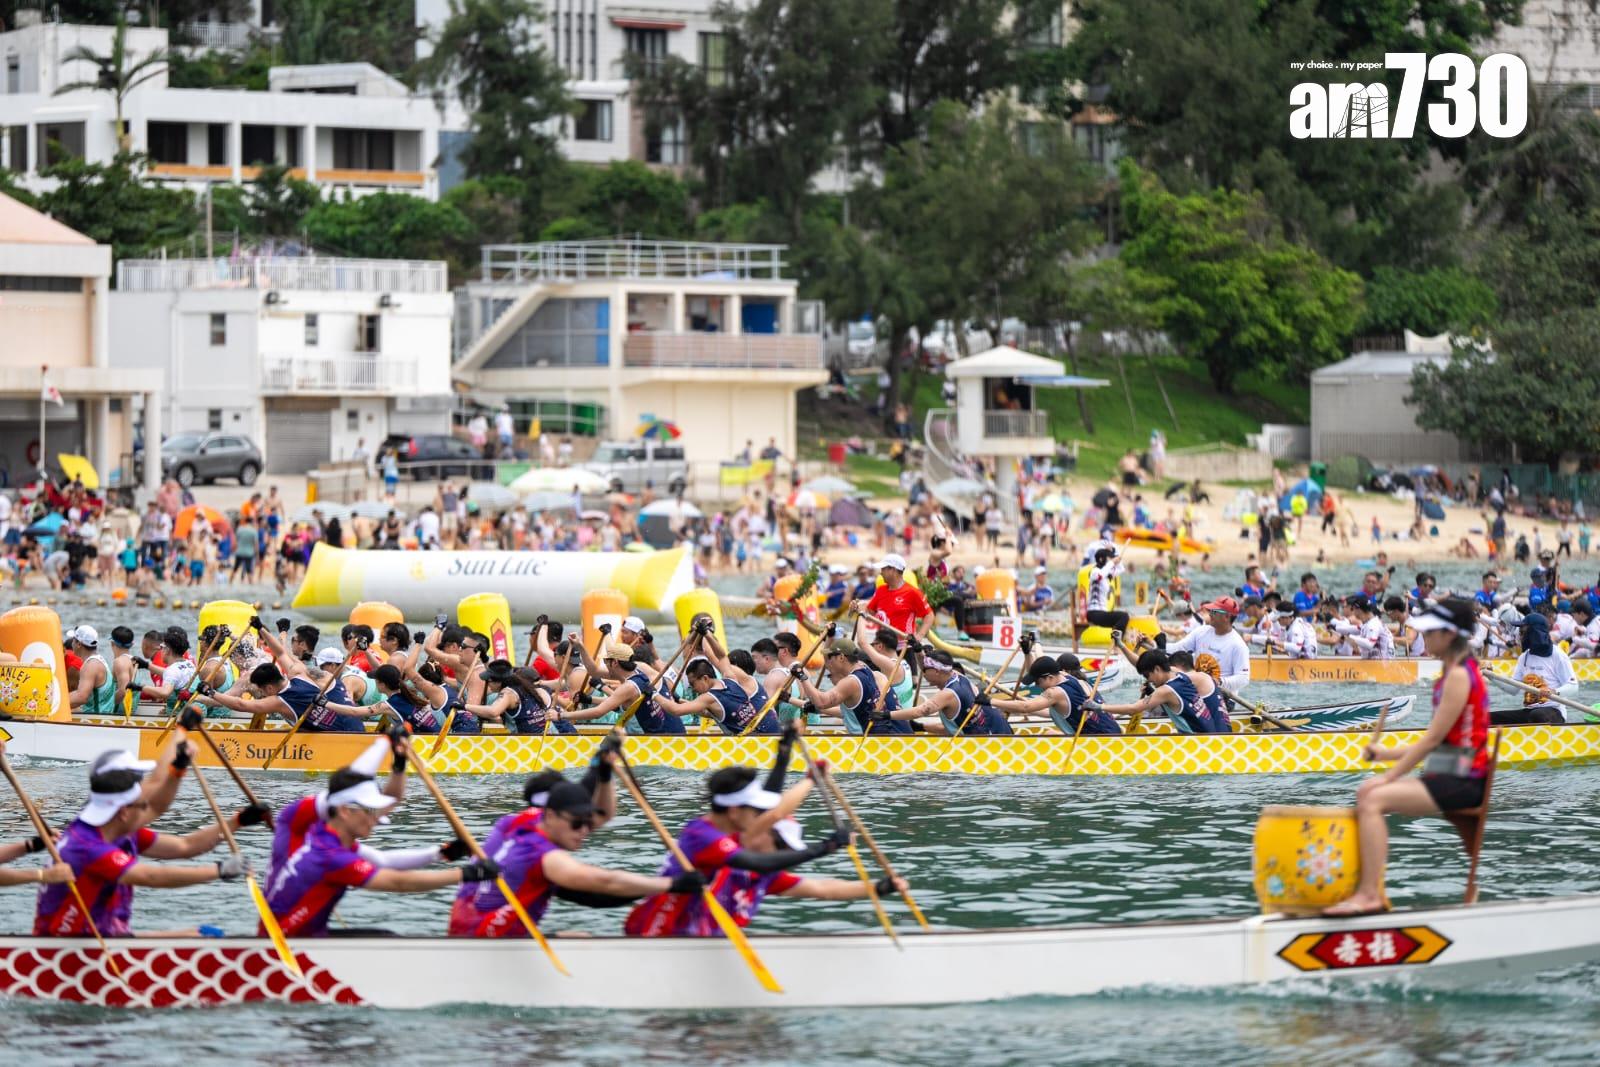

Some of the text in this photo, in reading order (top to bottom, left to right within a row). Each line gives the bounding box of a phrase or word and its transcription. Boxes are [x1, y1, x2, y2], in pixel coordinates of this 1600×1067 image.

[1000, 625, 1014, 648] 8
[1309, 667, 1360, 680] Sun Life
[282, 743, 314, 761] Life
[1332, 931, 1398, 966] 赤柱
